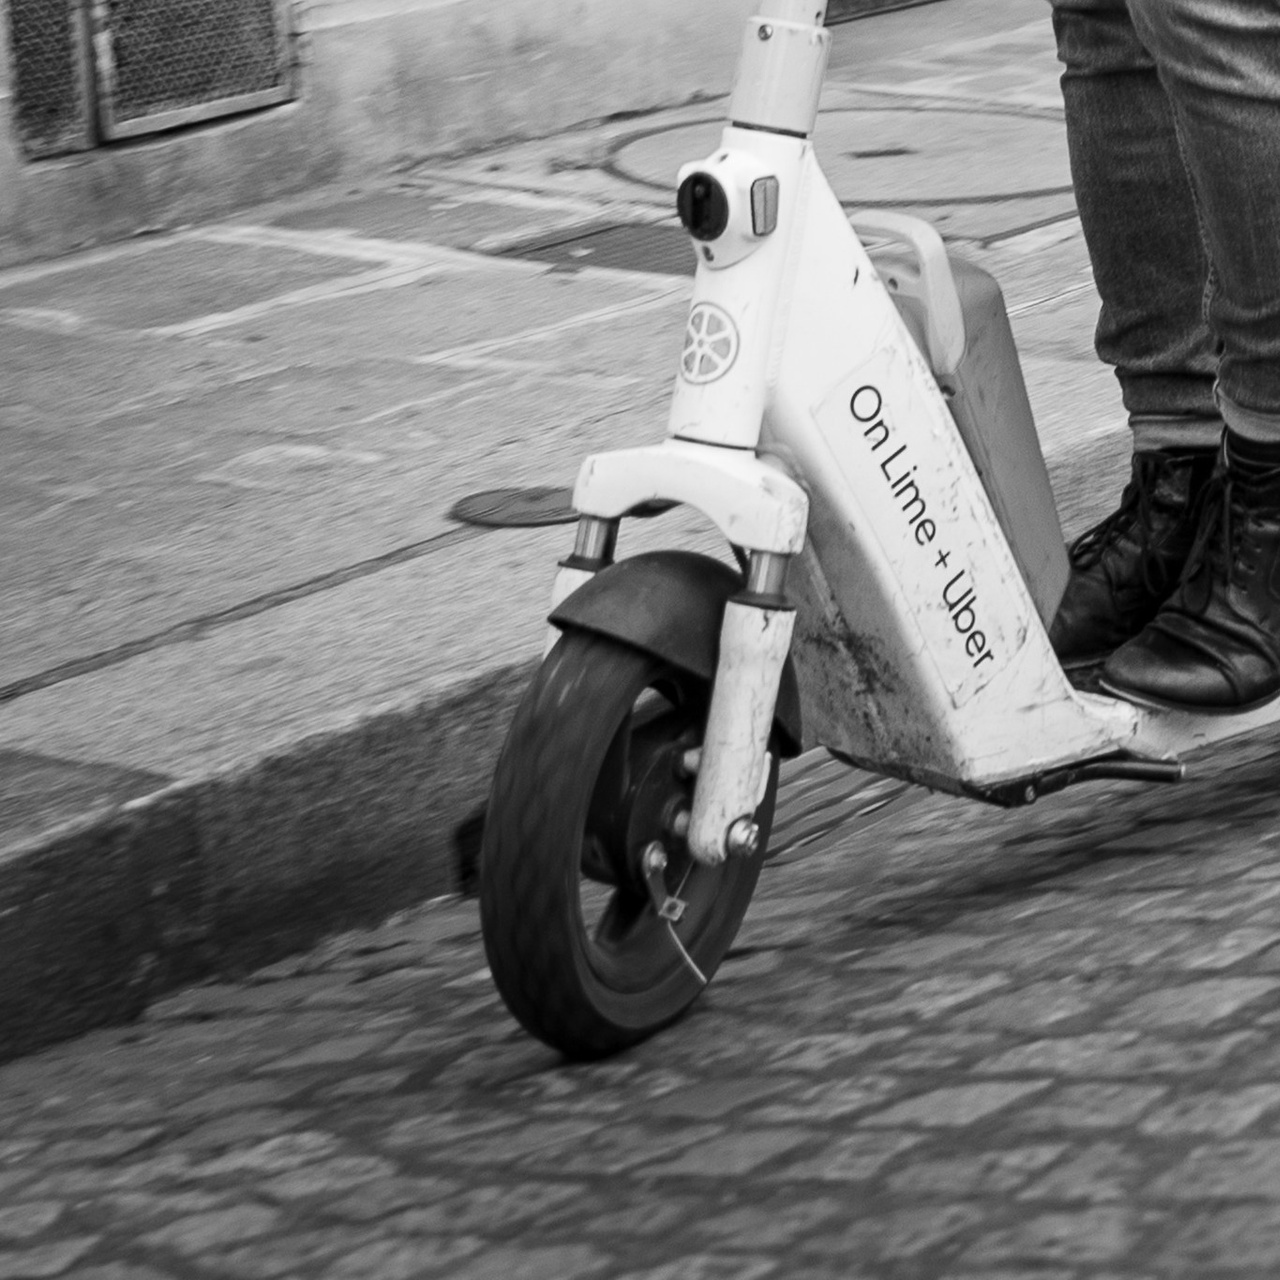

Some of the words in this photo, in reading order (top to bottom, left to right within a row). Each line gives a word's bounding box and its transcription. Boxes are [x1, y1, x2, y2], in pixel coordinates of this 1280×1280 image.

[850, 385, 889, 451] On
[880, 444, 936, 545] Lime
[935, 549, 951, 568] +
[942, 569, 994, 668] Uber
